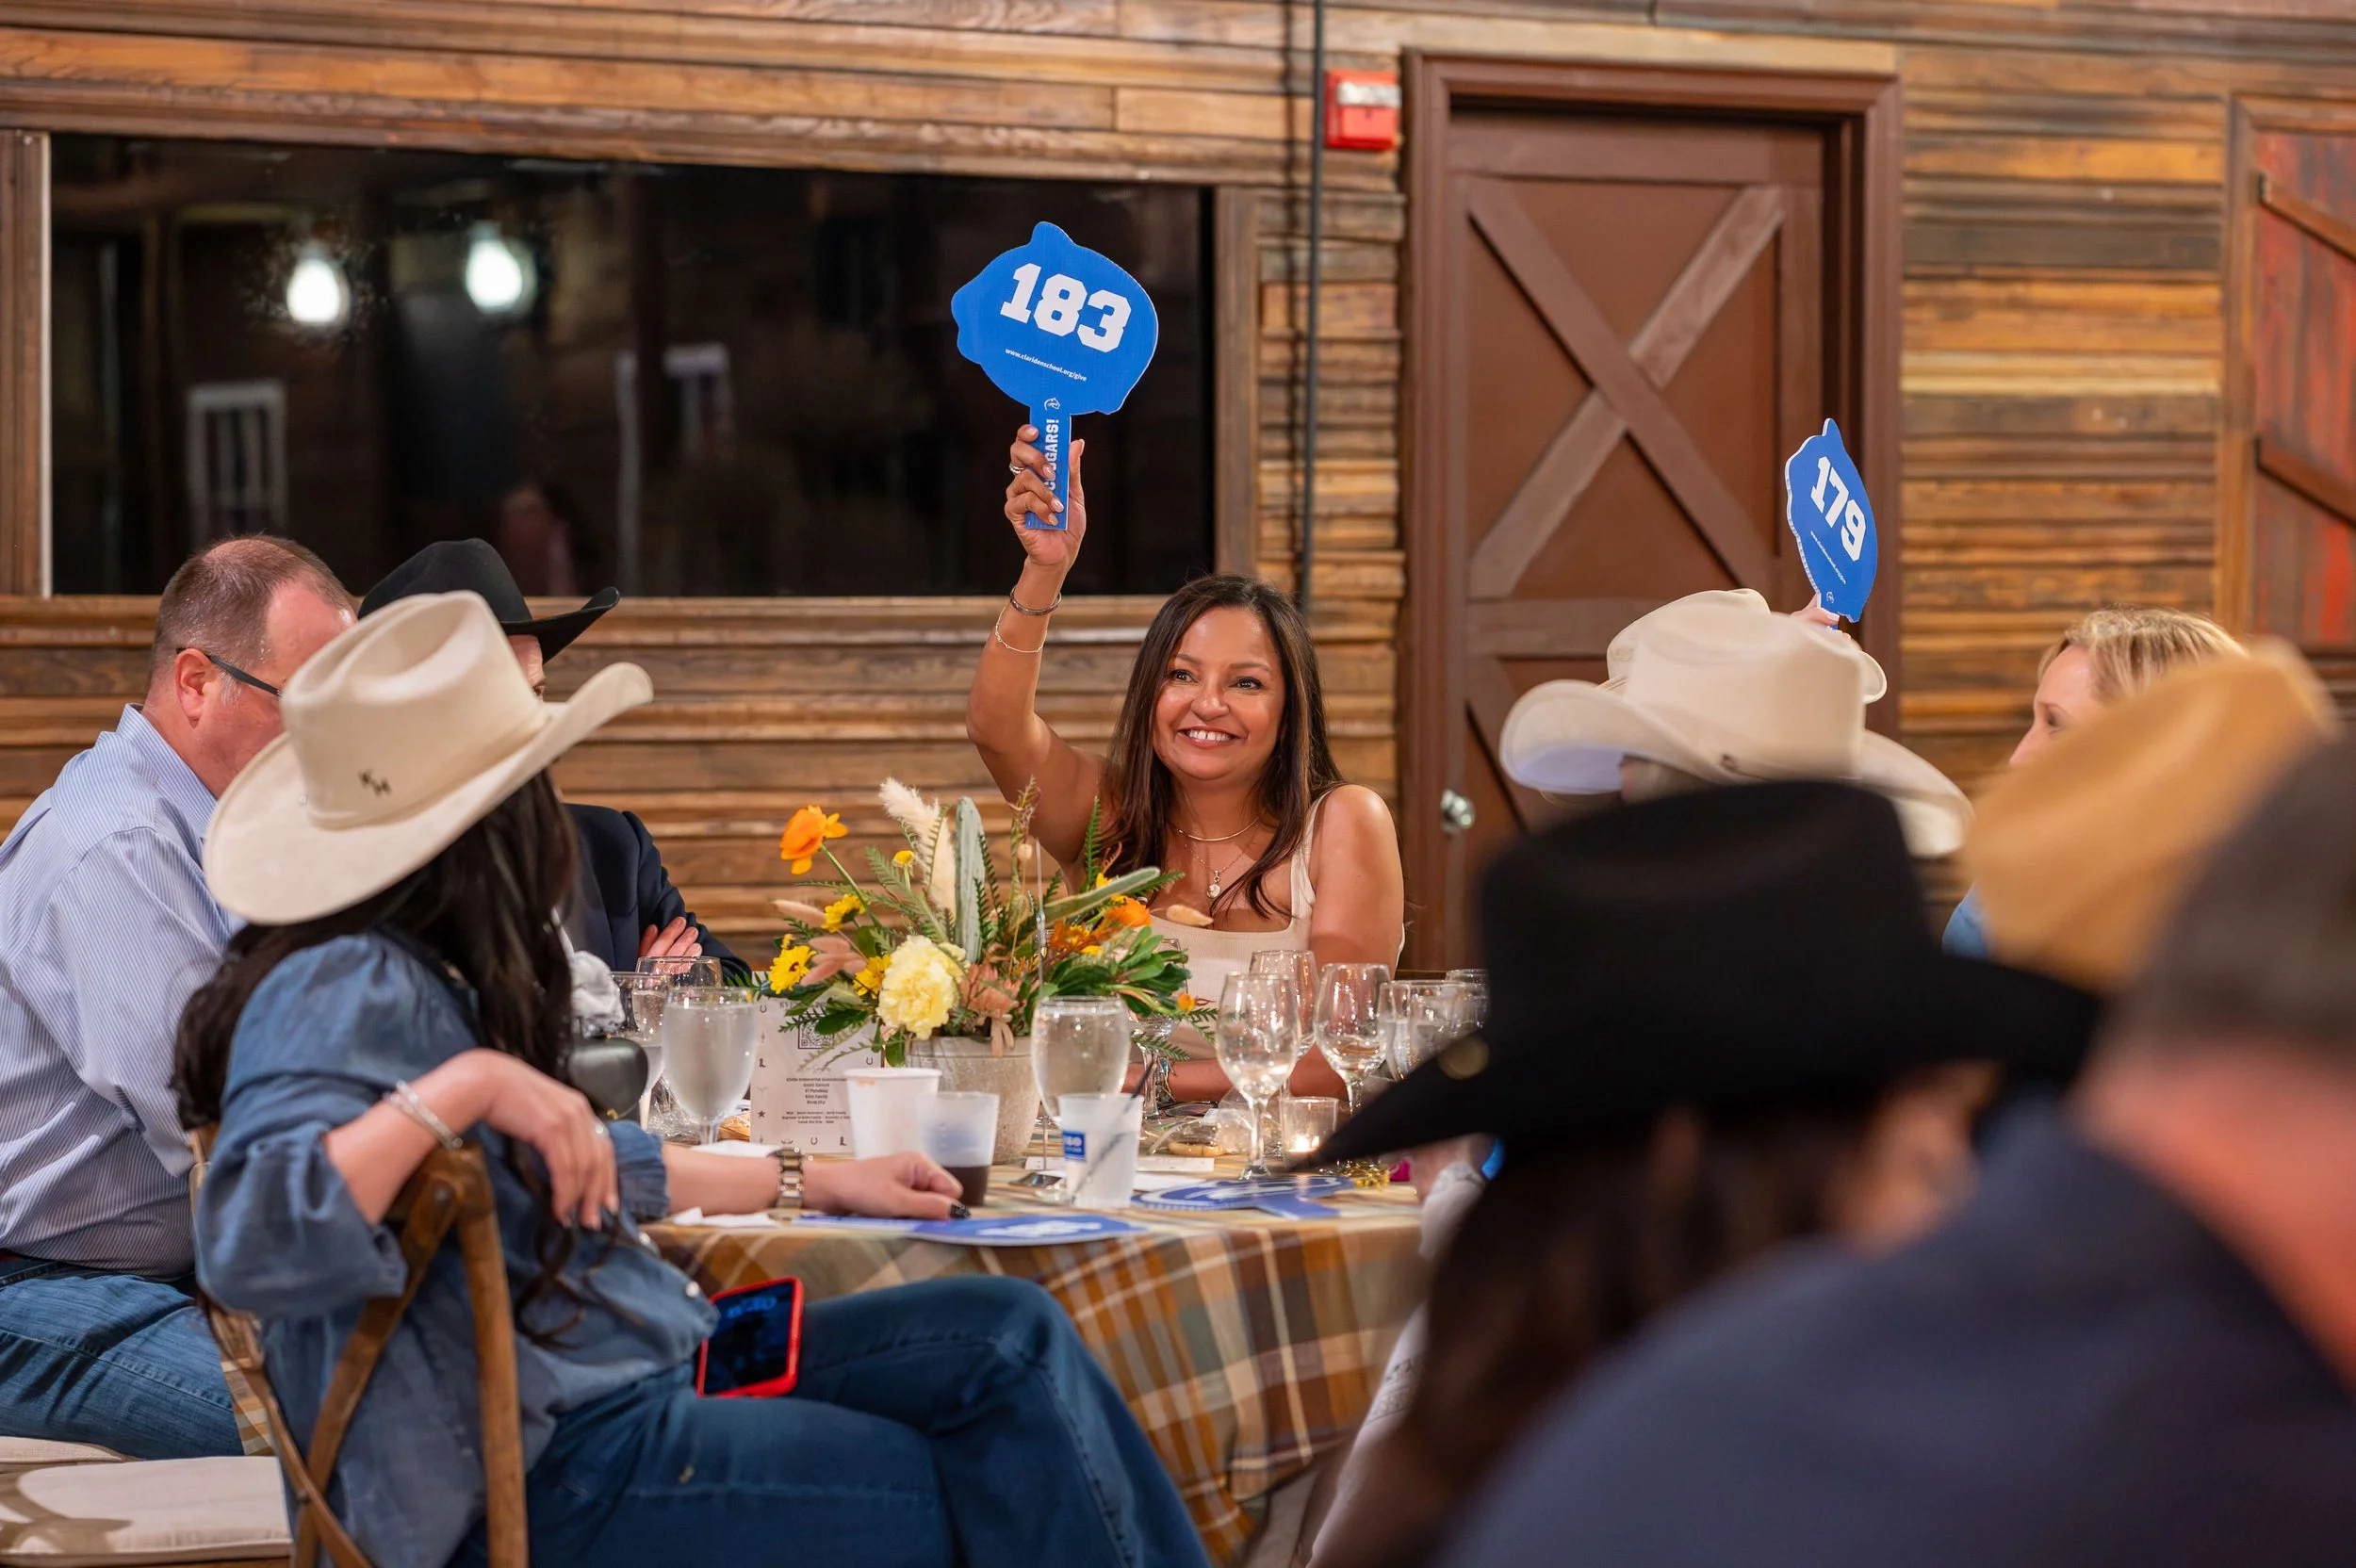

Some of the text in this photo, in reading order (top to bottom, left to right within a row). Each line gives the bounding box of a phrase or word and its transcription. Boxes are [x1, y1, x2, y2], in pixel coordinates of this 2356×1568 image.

[1000, 263, 1131, 352] 183
[1005, 348, 1088, 382] www.claridenschool.org/give
[1043, 418, 1059, 491] CGARS!
[1810, 456, 1866, 562] 179
